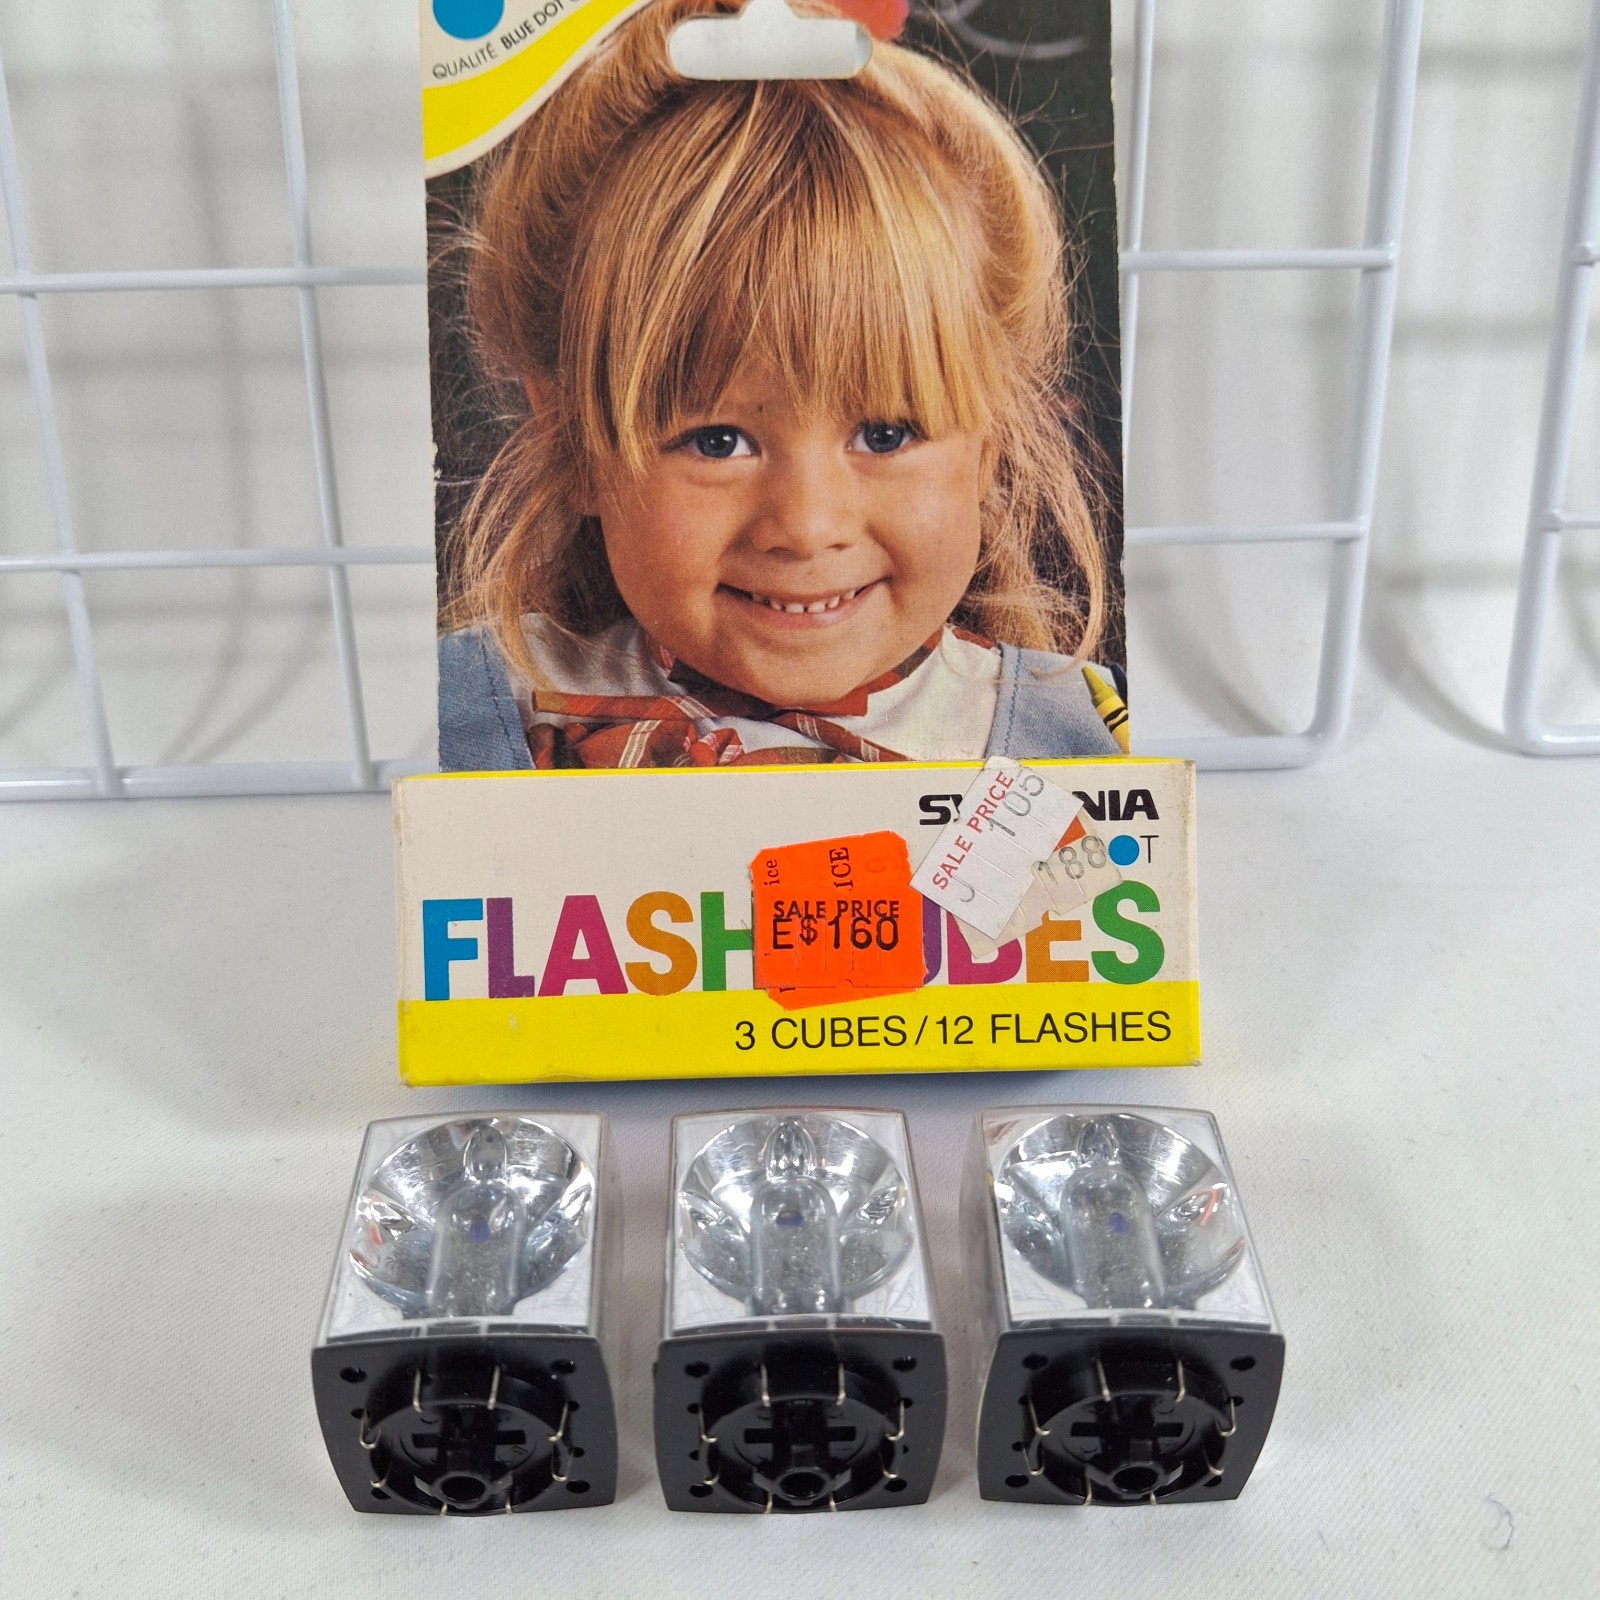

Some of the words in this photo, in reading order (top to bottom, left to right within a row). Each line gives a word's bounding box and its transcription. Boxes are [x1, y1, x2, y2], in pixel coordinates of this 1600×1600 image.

[432, 42, 498, 80] QUALITÉ
[500, 19, 535, 50] BLUE
[535, 0, 565, 27] DOT
[932, 834, 974, 890] SALE
[966, 771, 1015, 834] PRICE
[773, 901, 827, 919] SALE
[836, 899, 899, 919] PRICE
[734, 1020, 756, 1051] 3
[991, 1010, 1172, 1044] FLASHES
